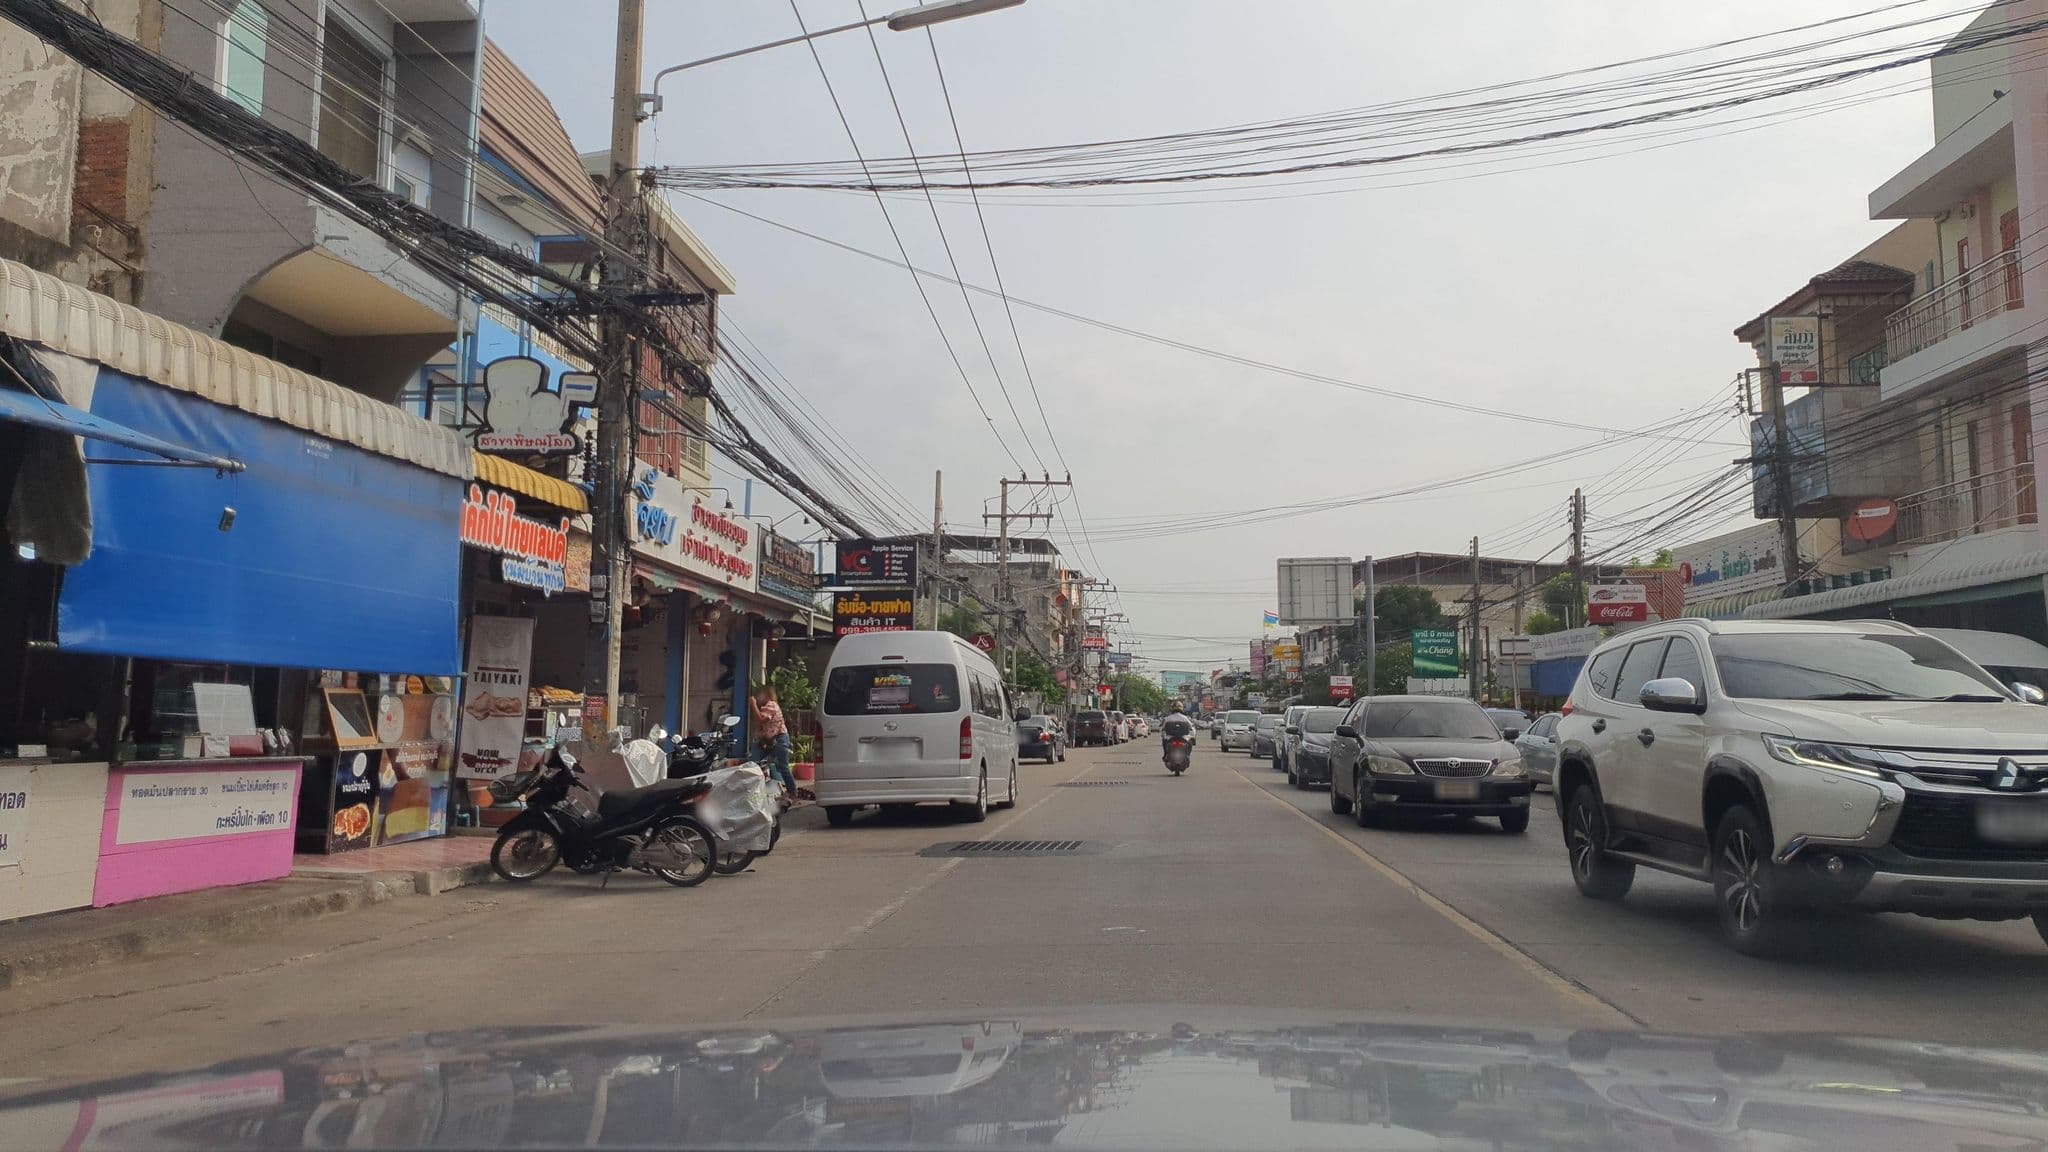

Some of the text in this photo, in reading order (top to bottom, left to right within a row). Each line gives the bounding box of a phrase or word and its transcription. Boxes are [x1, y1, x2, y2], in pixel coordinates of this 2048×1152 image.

[480, 433, 573, 452] สาขาพิษณุโลก
[837, 593, 912, 614] รับซื้อ-ขายฝาก
[851, 616, 896, 626] สินค้า IT
[1429, 646, 1454, 655] Chang
[473, 671, 522, 686] TAIYAKI
[200, 786, 208, 795] 30
[278, 811, 288, 823] 10
